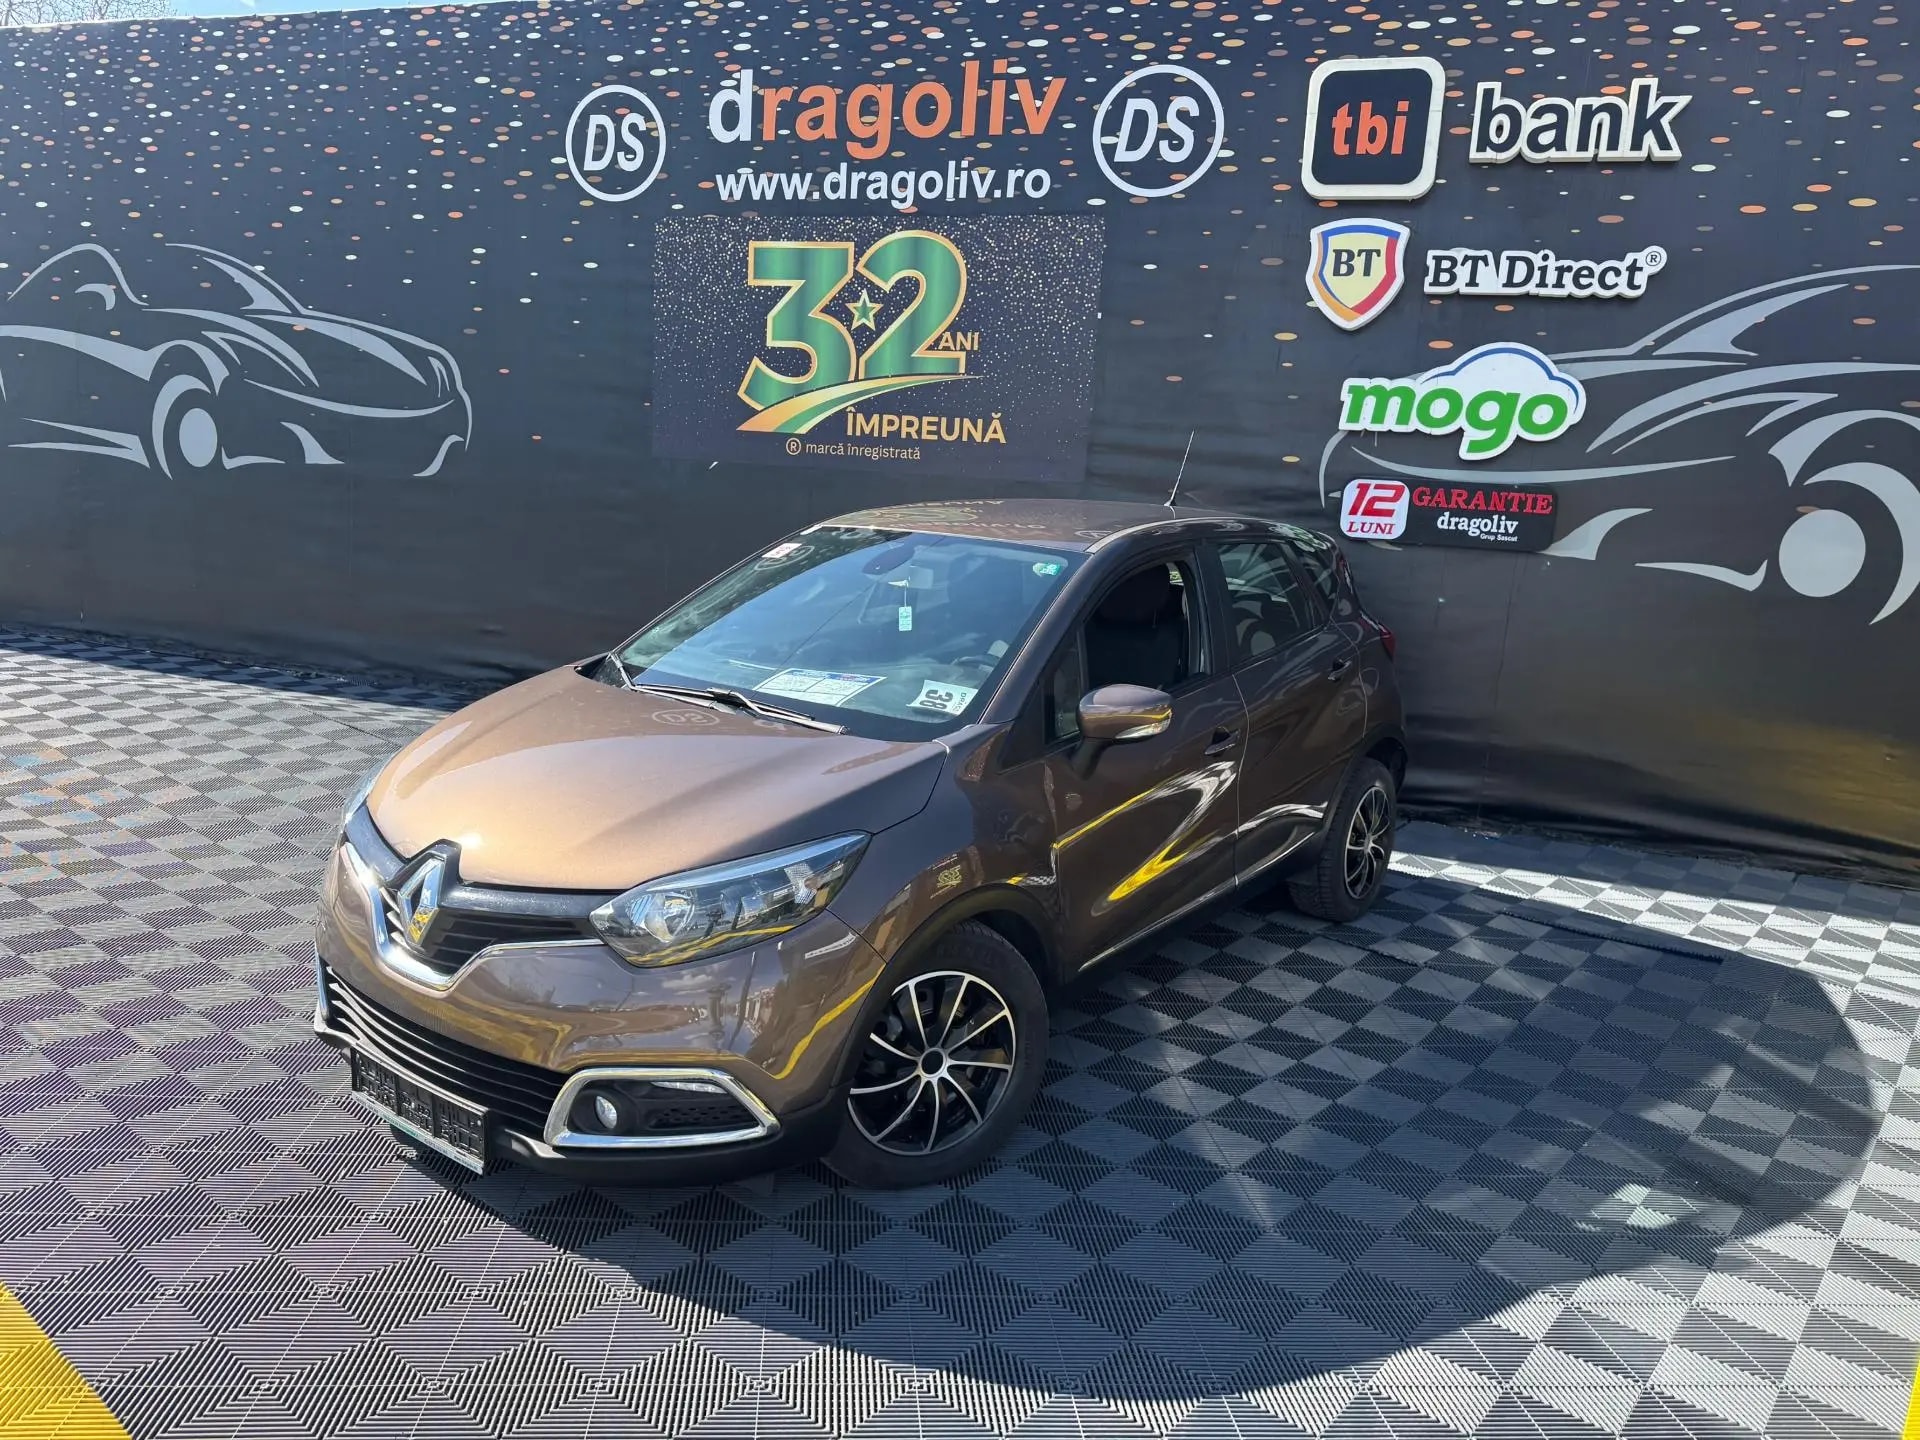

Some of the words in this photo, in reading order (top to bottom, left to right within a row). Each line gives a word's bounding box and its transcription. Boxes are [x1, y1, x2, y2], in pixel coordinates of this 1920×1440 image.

[708, 59, 1066, 159] dragoliv
[1474, 82, 1684, 157] bank
[584, 114, 647, 172] DS
[1114, 98, 1199, 163] DS
[1331, 100, 1410, 156] tbi
[716, 160, 1051, 209] www.dragoliv.ro
[1332, 248, 1381, 278] BT
[1428, 254, 1490, 288] BT
[737, 229, 968, 411] 32
[938, 331, 980, 351] ANI
[846, 407, 1007, 444] ÎMPREUNĂ
[1345, 384, 1568, 454] mogo
[805, 442, 844, 456] marcă
[847, 442, 921, 461] înregistrată
[1348, 482, 1405, 518] 12
[1412, 486, 1553, 515] GARANTIE
[1347, 521, 1397, 535] LUNI
[1437, 511, 1519, 537] dragoliv
